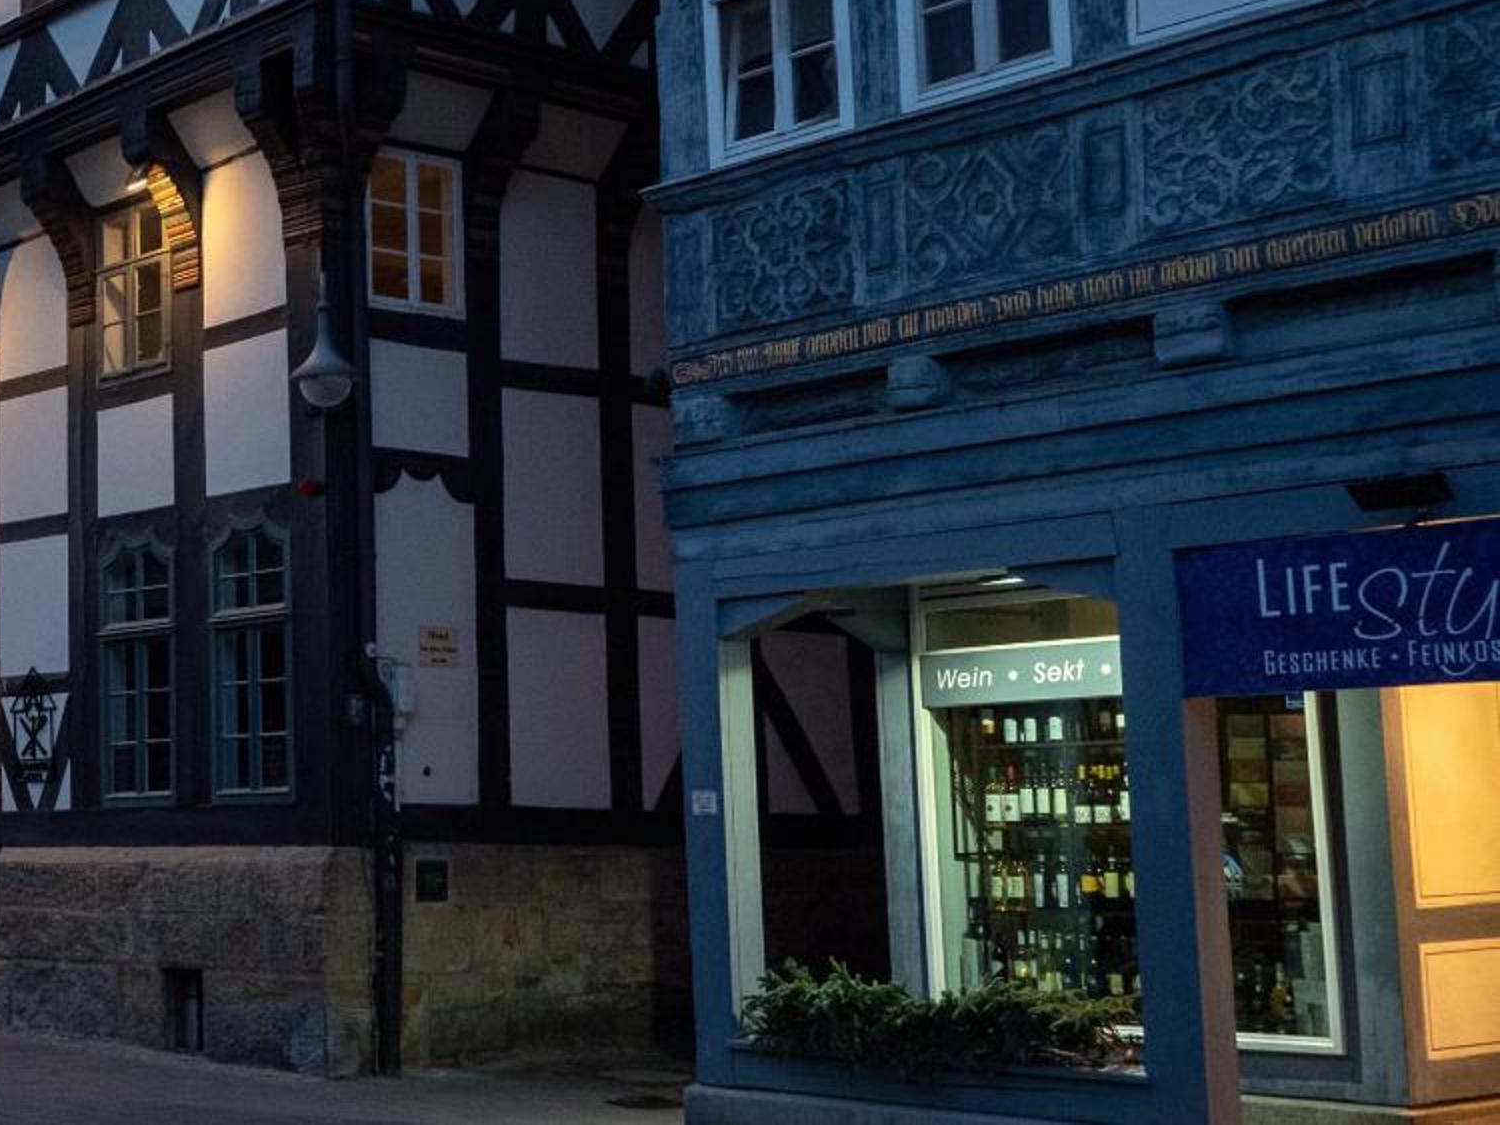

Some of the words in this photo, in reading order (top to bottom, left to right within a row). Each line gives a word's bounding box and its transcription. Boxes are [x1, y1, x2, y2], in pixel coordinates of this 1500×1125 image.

[936, 667, 993, 690] Wein
[1033, 658, 1085, 684] Sekt
[1263, 647, 1381, 676] GESCHENKE
